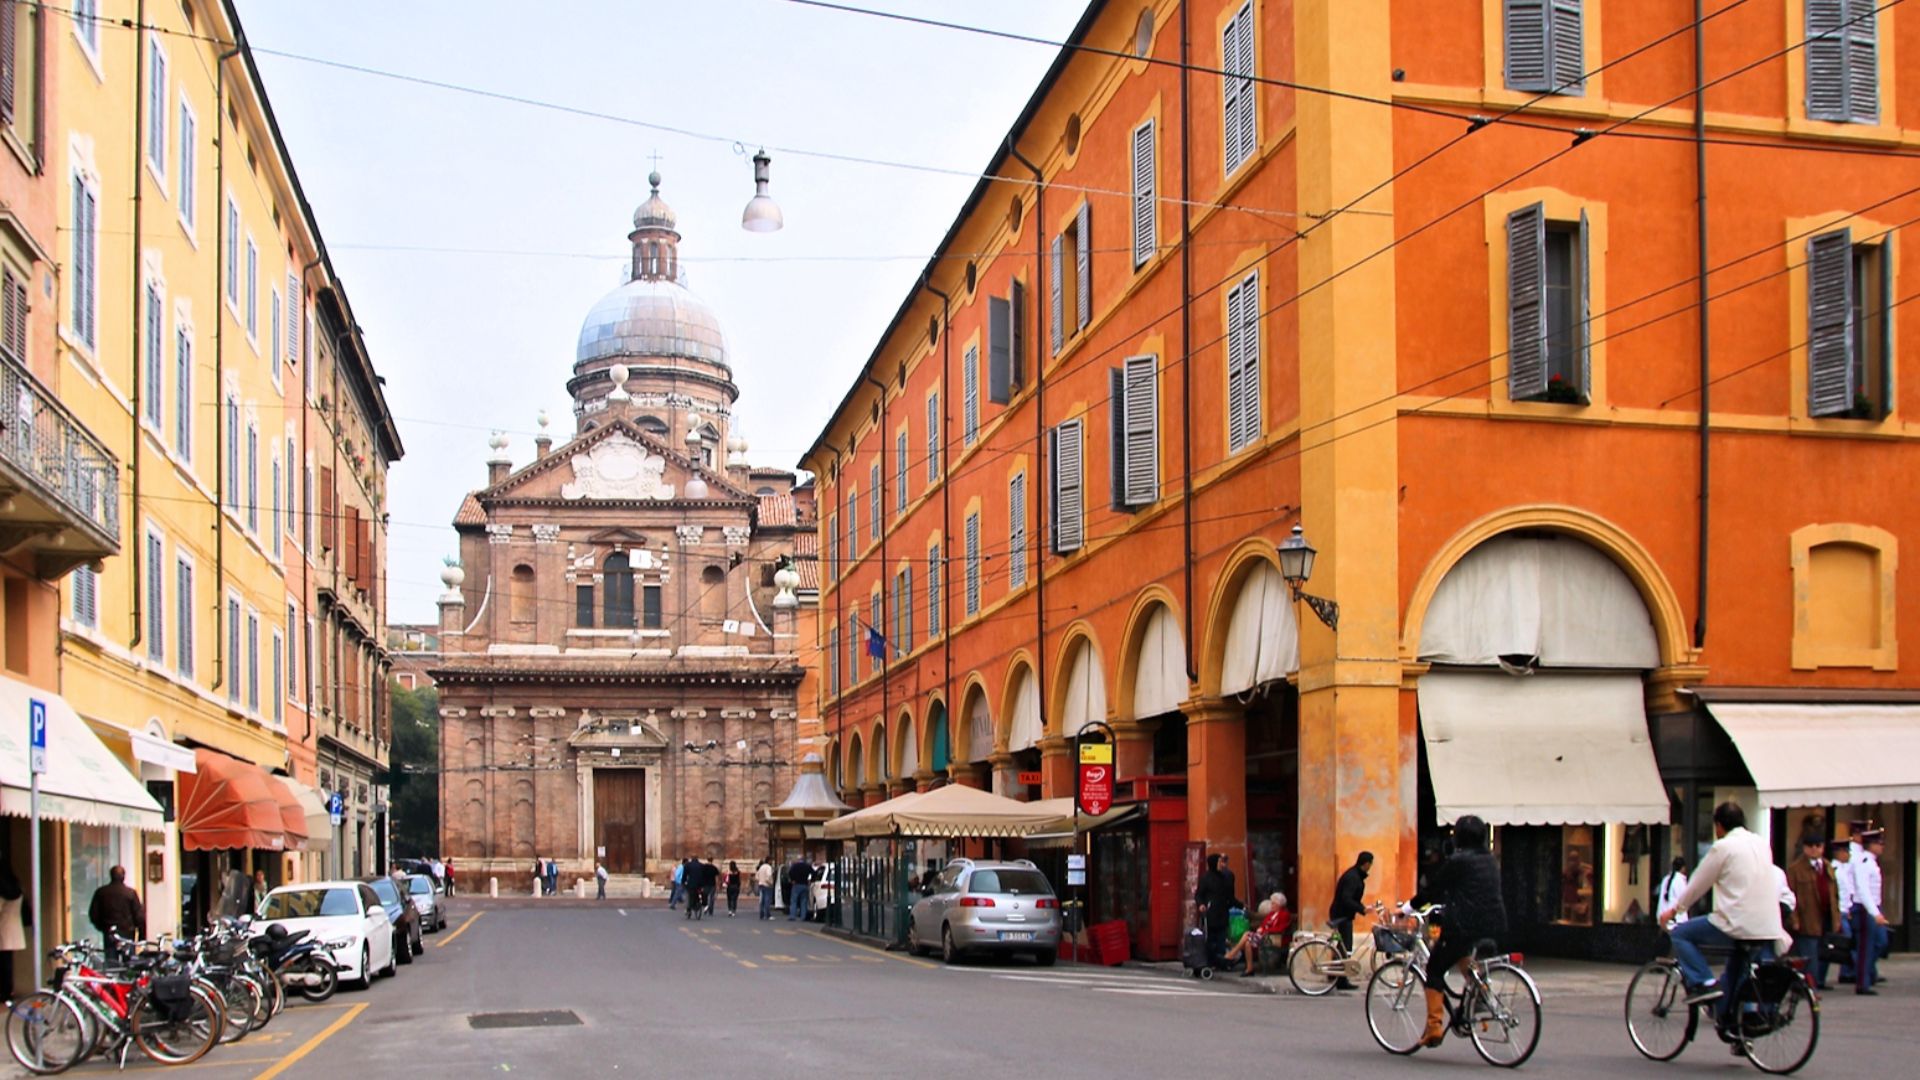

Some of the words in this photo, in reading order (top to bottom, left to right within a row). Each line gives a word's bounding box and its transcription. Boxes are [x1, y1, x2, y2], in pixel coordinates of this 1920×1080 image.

[34, 705, 44, 743] P
[1021, 774, 1039, 782] TAXI
[332, 796, 339, 811] P
